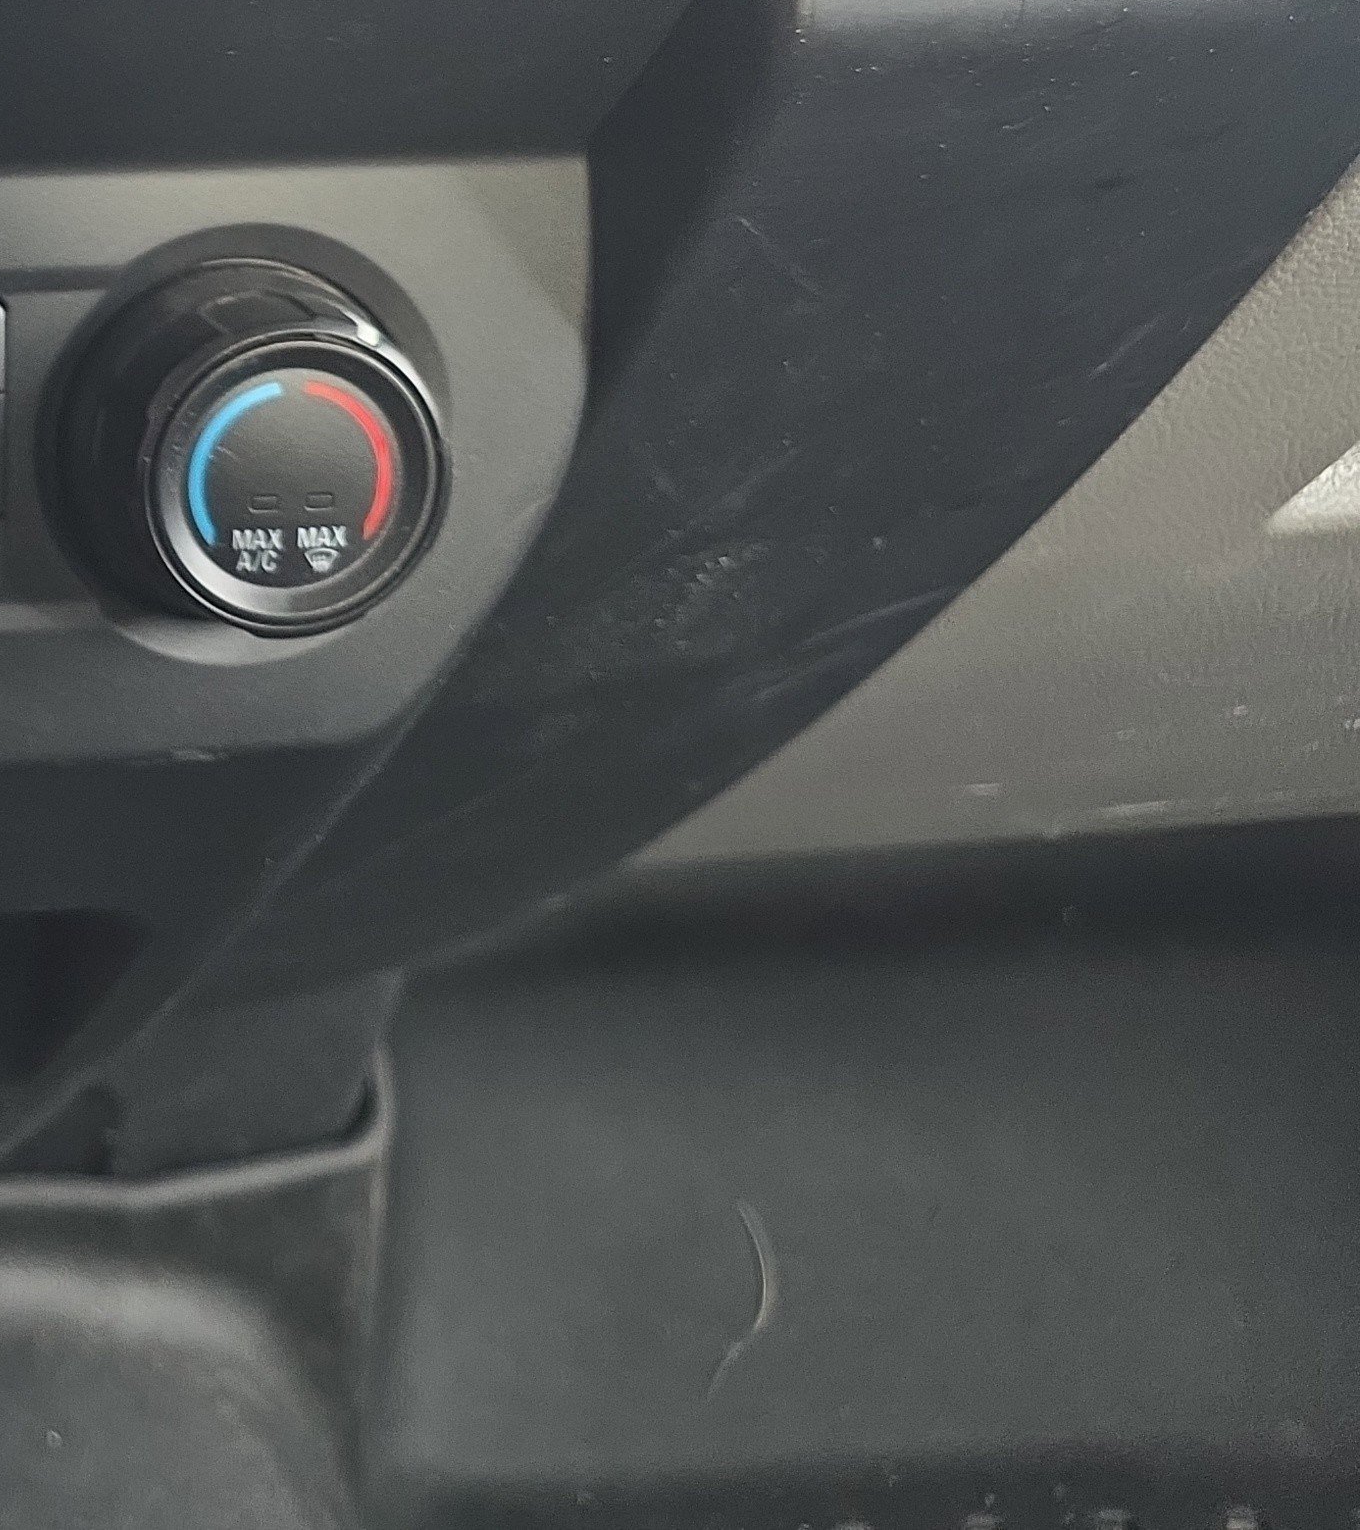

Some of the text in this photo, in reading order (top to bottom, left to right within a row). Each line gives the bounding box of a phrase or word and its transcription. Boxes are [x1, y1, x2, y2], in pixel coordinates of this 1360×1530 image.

[232, 529, 284, 550] MAX
[297, 525, 347, 548] MAX
[236, 550, 279, 572] A/C
